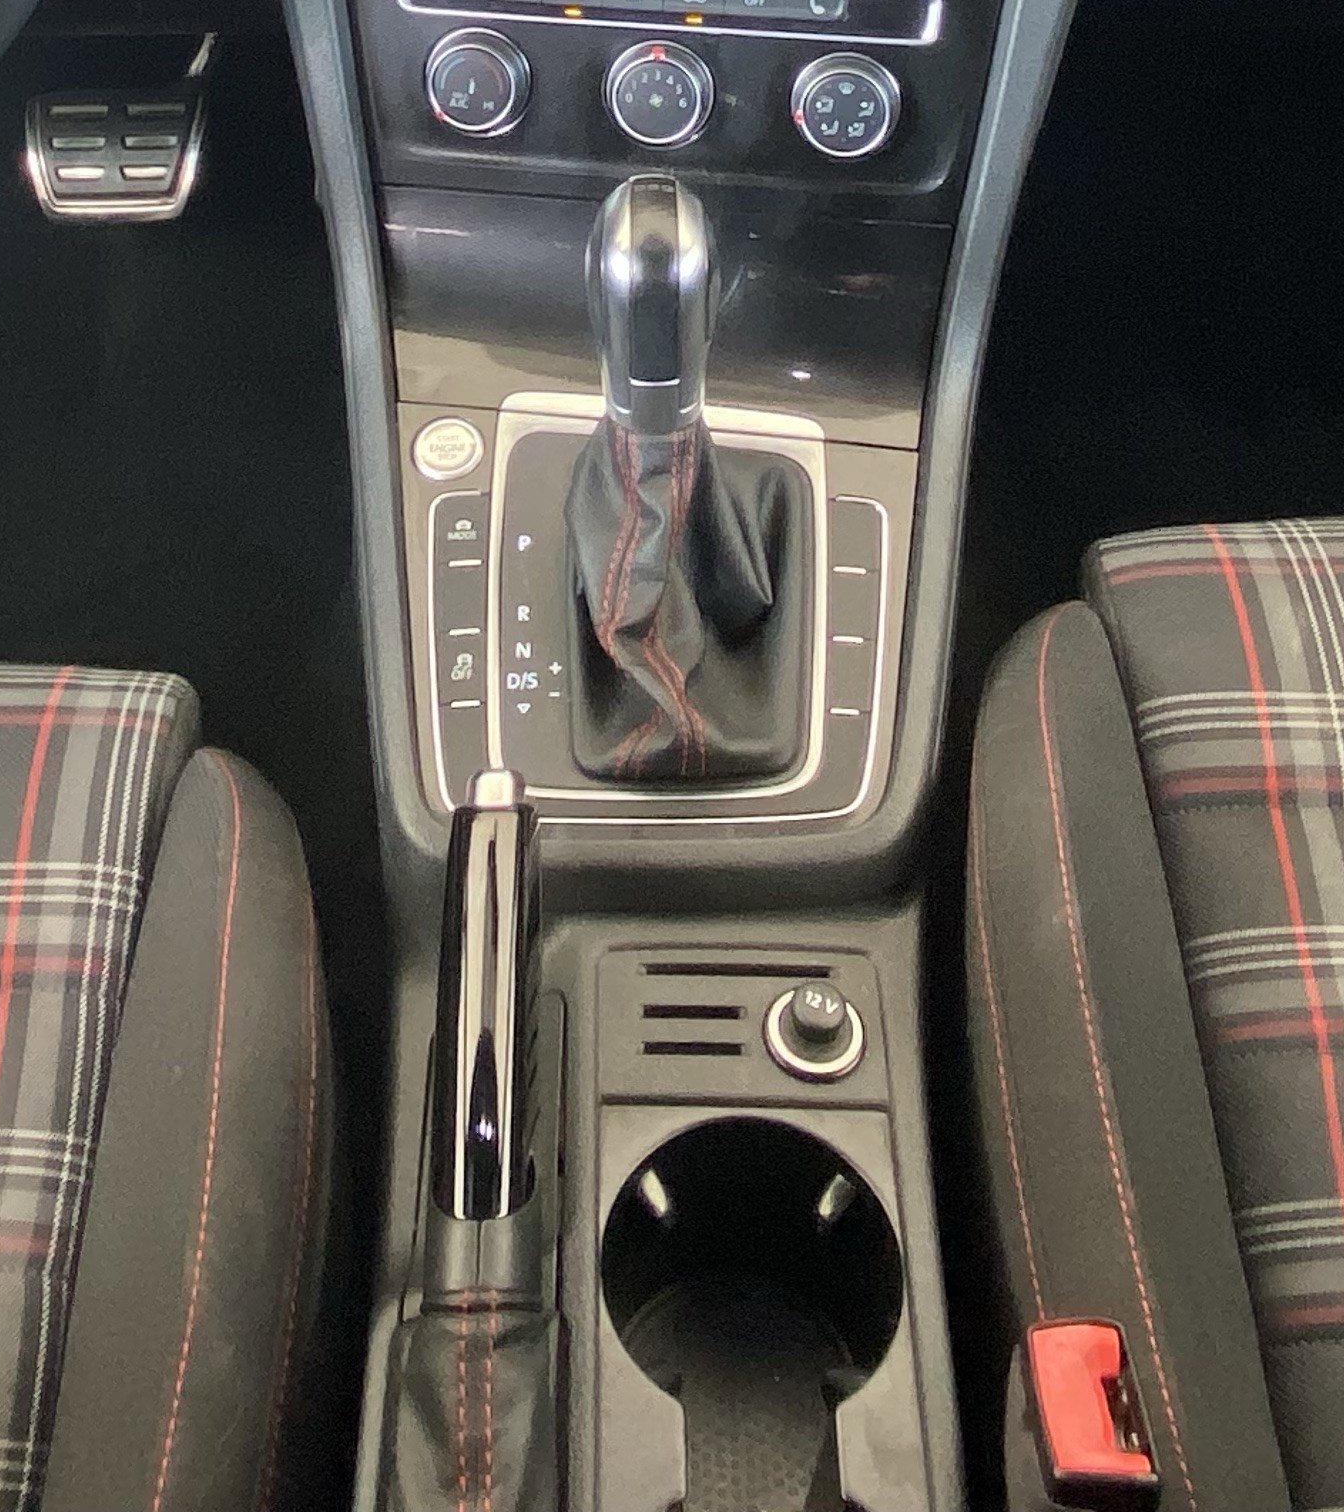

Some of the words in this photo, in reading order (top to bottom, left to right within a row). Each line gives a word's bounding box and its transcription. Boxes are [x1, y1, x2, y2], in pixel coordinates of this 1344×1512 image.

[666, 75, 674, 85] 4
[624, 91, 633, 103] 0
[679, 97, 687, 108] 6
[517, 535, 532, 552] P
[517, 604, 531, 621] R
[515, 642, 532, 659] N
[506, 671, 539, 690] D/S
